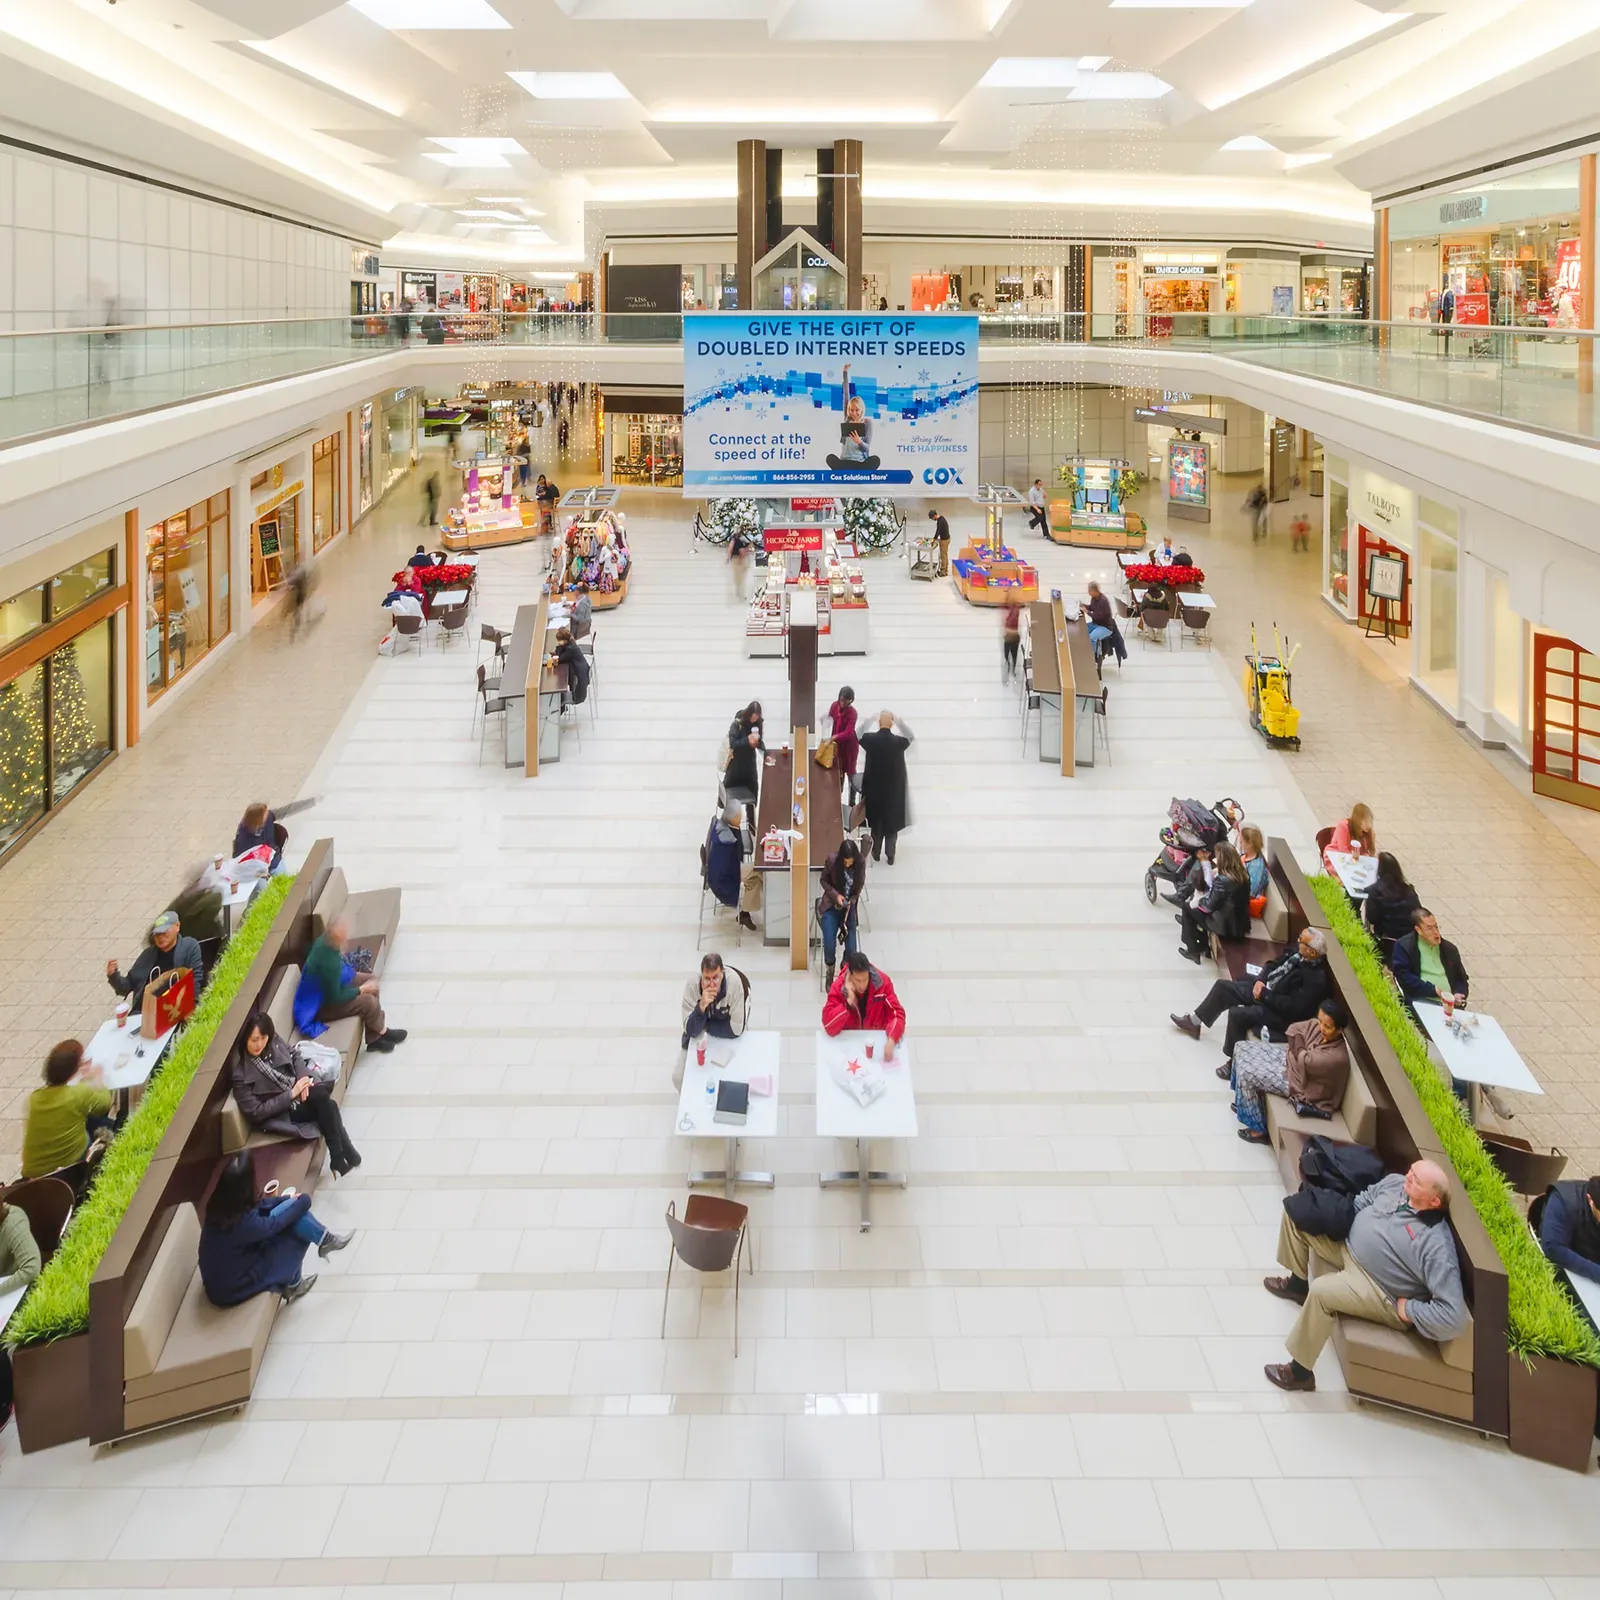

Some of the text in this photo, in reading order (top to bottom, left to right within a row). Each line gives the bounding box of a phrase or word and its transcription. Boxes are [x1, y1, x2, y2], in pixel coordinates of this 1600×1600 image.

[748, 322, 916, 337] GIVE THE GIFT OF
[698, 341, 966, 356] DOUBLED INTERNET SPEEDS
[709, 433, 812, 446] Connect at the
[911, 435, 953, 445] Bring Home
[896, 445, 968, 453] THE HAPPINESS
[714, 448, 806, 462] speed of life!
[708, 473, 758, 482] cox.com/internet
[772, 473, 816, 482] 866-856-2955
[830, 473, 844, 481] Cox
[844, 473, 870, 481] Solutions
[922, 467, 965, 486] COX
[1367, 491, 1401, 518] TALBOTS
[766, 535, 820, 545] HICKORY FARMS
